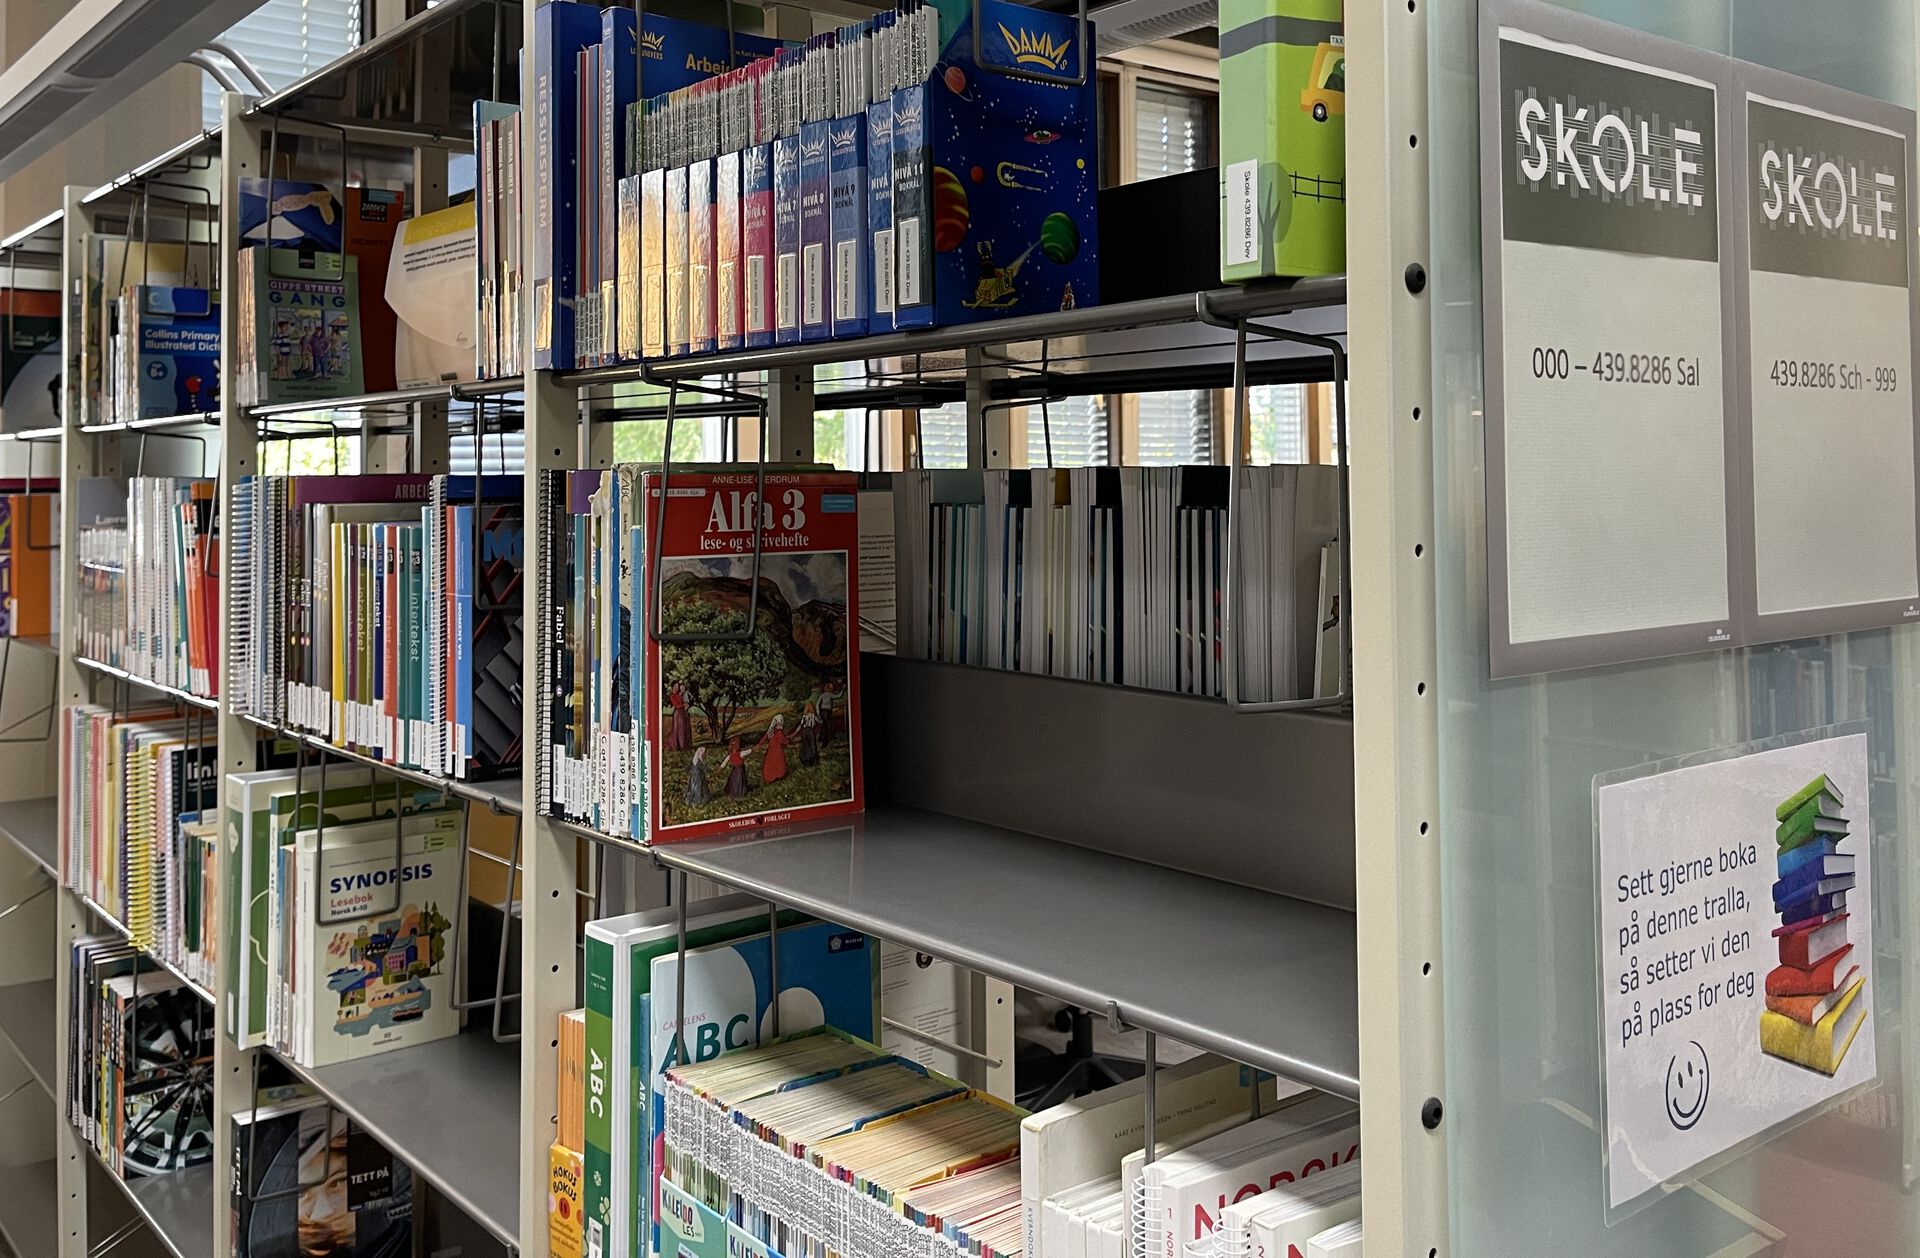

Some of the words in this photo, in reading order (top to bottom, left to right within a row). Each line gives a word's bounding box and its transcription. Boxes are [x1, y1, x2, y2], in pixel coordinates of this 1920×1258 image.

[1331, 36, 1344, 46] TAX
[539, 75, 547, 228] RESSURSPERM
[1519, 97, 1703, 207] SKOLE
[871, 174, 888, 190] NIVÅ
[895, 165, 912, 182] NIVÅ
[914, 162, 924, 178] 11
[803, 191, 818, 208] NIVÅ
[819, 191, 825, 204] 8
[833, 182, 850, 199] NIVÅ
[875, 189, 892, 201] BOKM
[1761, 149, 1897, 241] SKOLE
[269, 291, 346, 308] GANG
[304, 284, 345, 295] STREET
[145, 329, 178, 340] Collins
[181, 330, 220, 343] Primary
[145, 340, 196, 351] Illustrated
[1532, 347, 1569, 379] 000
[1592, 352, 1671, 385] 439.8286
[1677, 357, 1700, 386] Sal
[1770, 360, 1835, 389] 439.8286
[1839, 364, 1863, 390] Sch
[1875, 367, 1897, 391] 999
[712, 476, 753, 484] ANNE-LISE
[755, 476, 800, 484] ERDRUM
[704, 491, 775, 533] Alfa
[783, 489, 806, 530] 3
[700, 535, 726, 550] lese-
[730, 537, 743, 552] og
[411, 592, 420, 662] intertekst
[555, 606, 564, 643] Fabel
[1617, 869, 1654, 902] Sett
[1660, 857, 1713, 896] gjerne
[1719, 842, 1757, 872] boka
[331, 893, 374, 908] Lesebok
[331, 906, 351, 917] Norsk
[1619, 910, 1640, 956] på
[1647, 905, 1698, 939] denne
[1704, 886, 1750, 920] tralla,
[1620, 956, 1640, 994] så
[1646, 949, 1696, 985] setter
[1701, 936, 1715, 964] vi
[1721, 930, 1750, 957] den
[1622, 1001, 1642, 1048] på
[1650, 995, 1692, 1036] plass
[1698, 983, 1721, 1010] for
[1726, 971, 1754, 998] deg
[663, 1012, 706, 1031] CAELENS
[659, 1013, 750, 1074] ABC
[590, 1048, 603, 1119] ABC
[350, 1173, 374, 1185] TETT
[375, 1166, 390, 1182] PÅ
[553, 1166, 577, 1187] HOKUS
[553, 1181, 577, 1202] BOKUS
[662, 1188, 693, 1226] KALEIDO
[683, 1225, 694, 1237] LES
